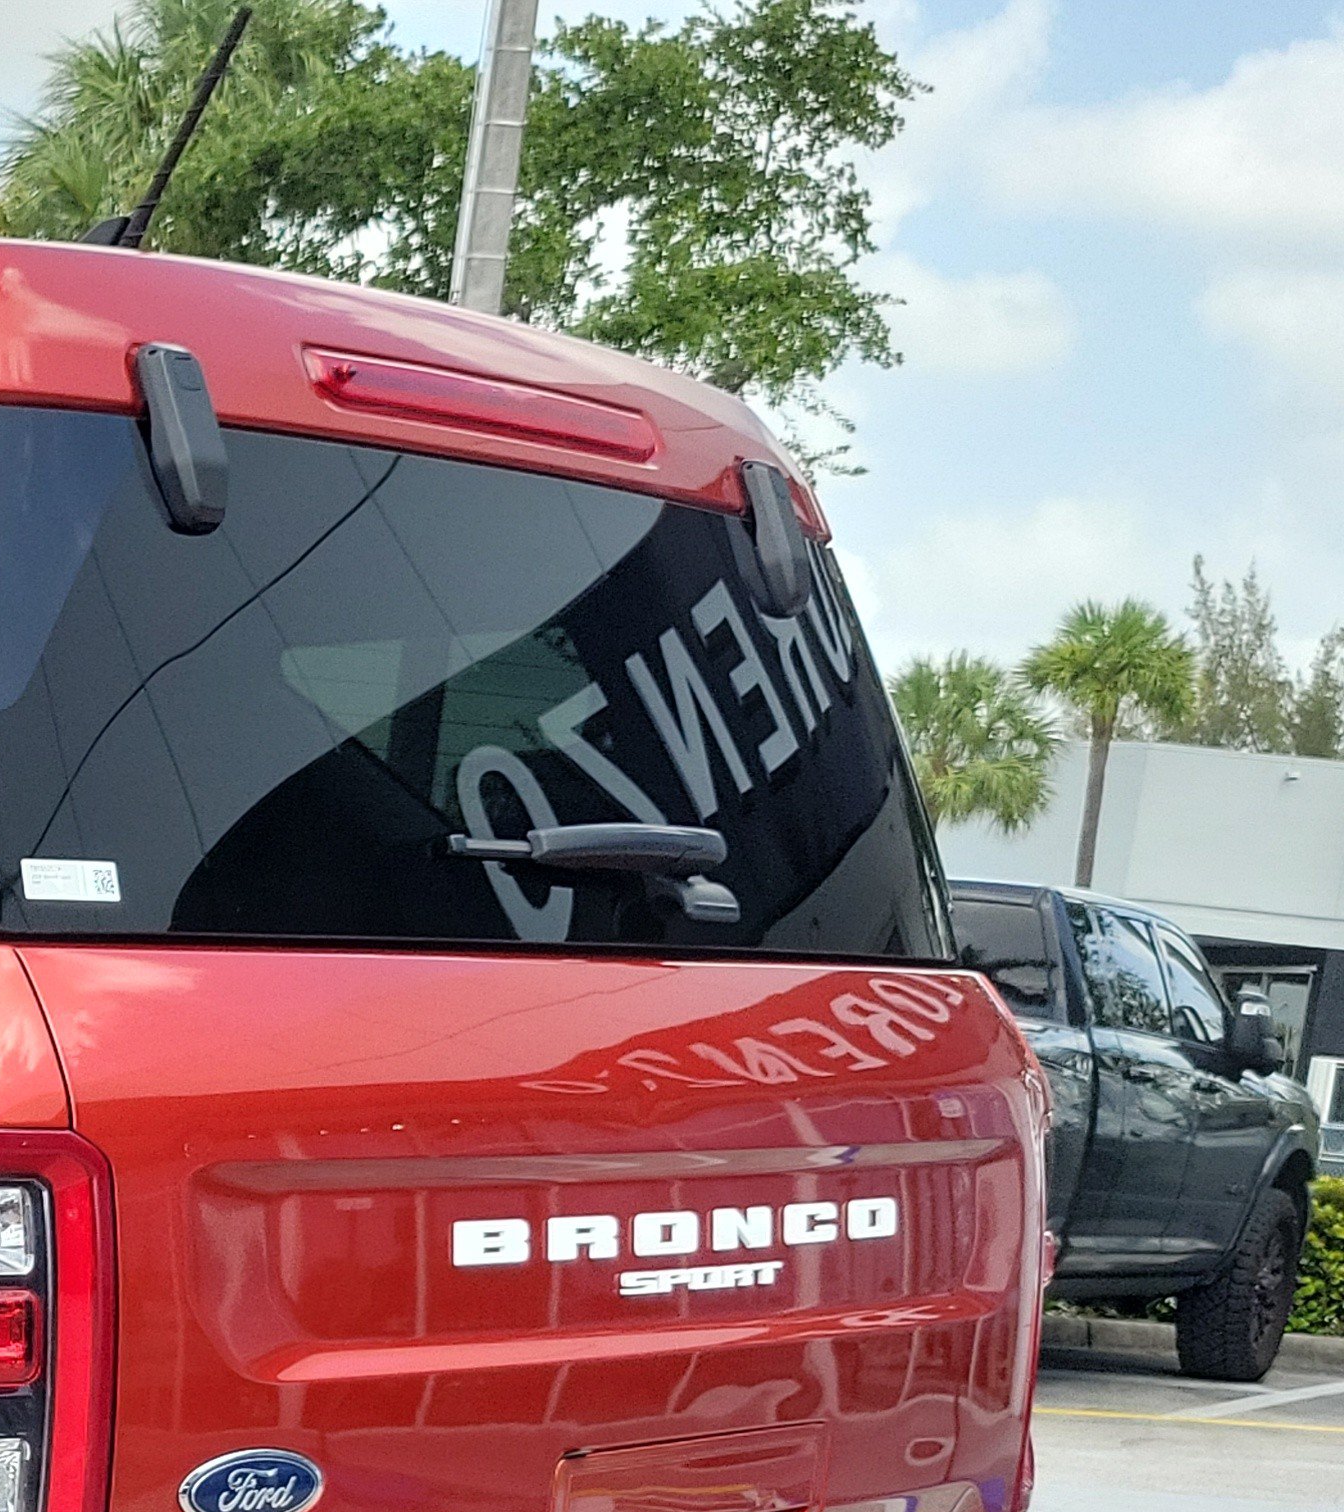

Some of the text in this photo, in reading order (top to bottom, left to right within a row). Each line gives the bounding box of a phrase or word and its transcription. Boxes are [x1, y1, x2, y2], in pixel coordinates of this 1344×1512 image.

[451, 1196, 898, 1267] BRONCO
[618, 1260, 784, 1296] SPORT
[218, 1466, 298, 1512] Ford
